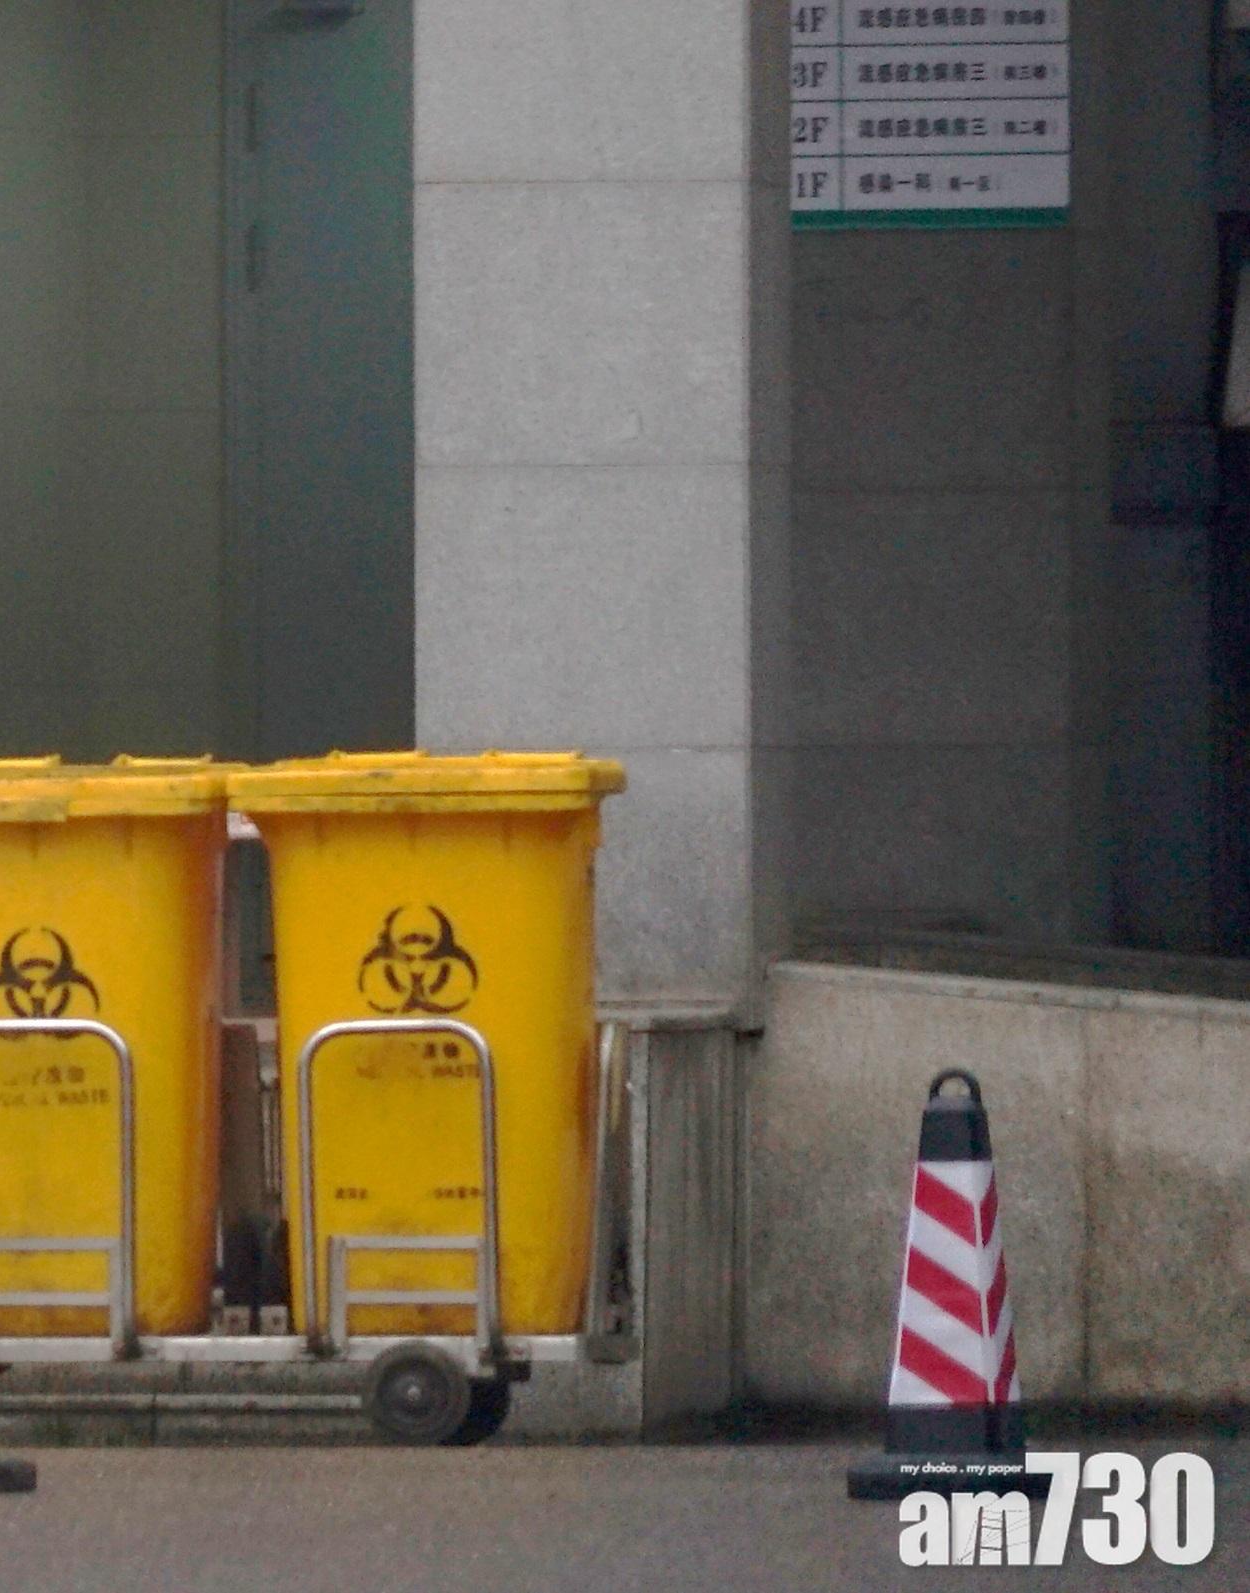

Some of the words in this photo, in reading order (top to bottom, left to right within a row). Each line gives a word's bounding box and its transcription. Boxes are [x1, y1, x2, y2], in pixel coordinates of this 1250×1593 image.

[794, 7, 826, 33] 4F
[793, 61, 828, 88] 3F
[793, 117, 829, 143] 2F
[796, 172, 828, 198] 1F
